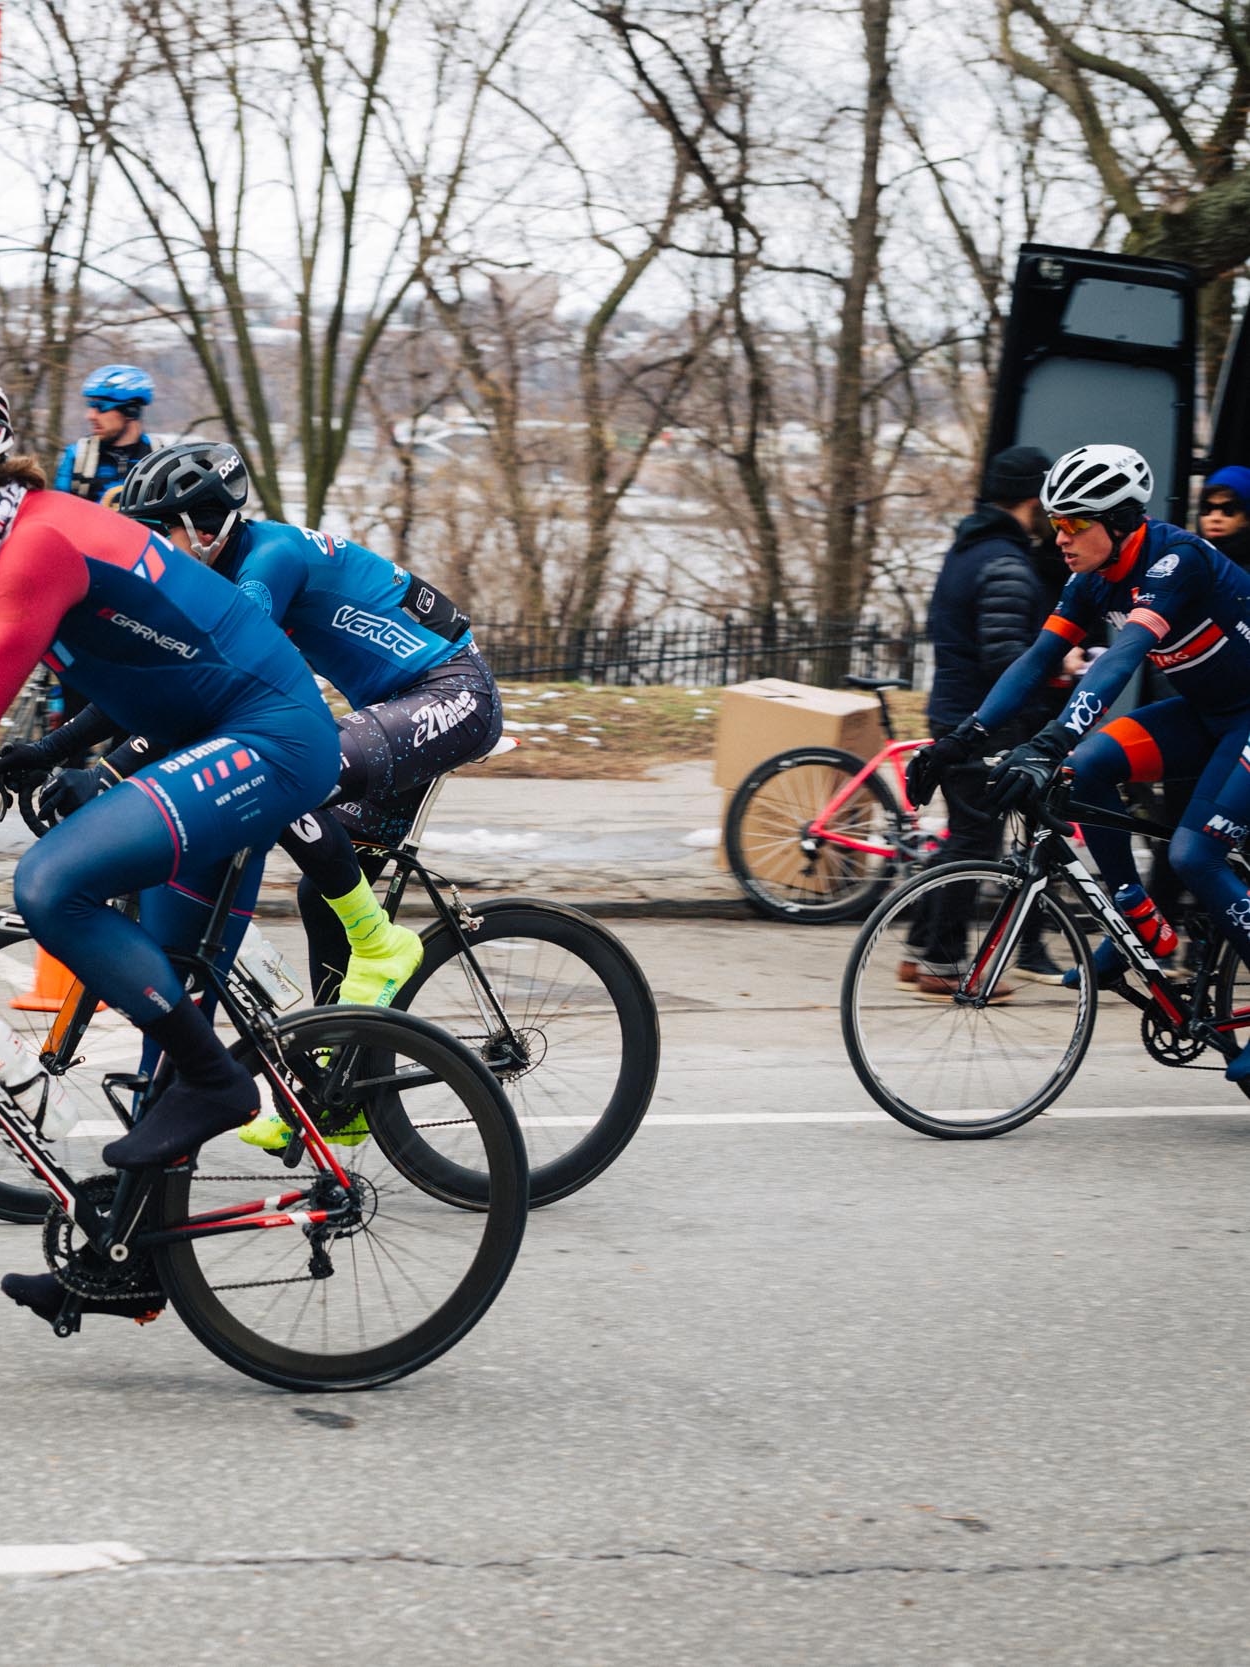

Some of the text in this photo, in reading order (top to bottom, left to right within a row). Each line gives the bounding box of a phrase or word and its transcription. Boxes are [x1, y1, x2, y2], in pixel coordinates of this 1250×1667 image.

[219, 455, 240, 480] POC
[111, 613, 200, 660] GARNEAU
[331, 605, 428, 659] VERGE
[158, 760, 181, 774] TO
[174, 753, 196, 767] BE
[215, 774, 266, 807] NEW YORK CITY
